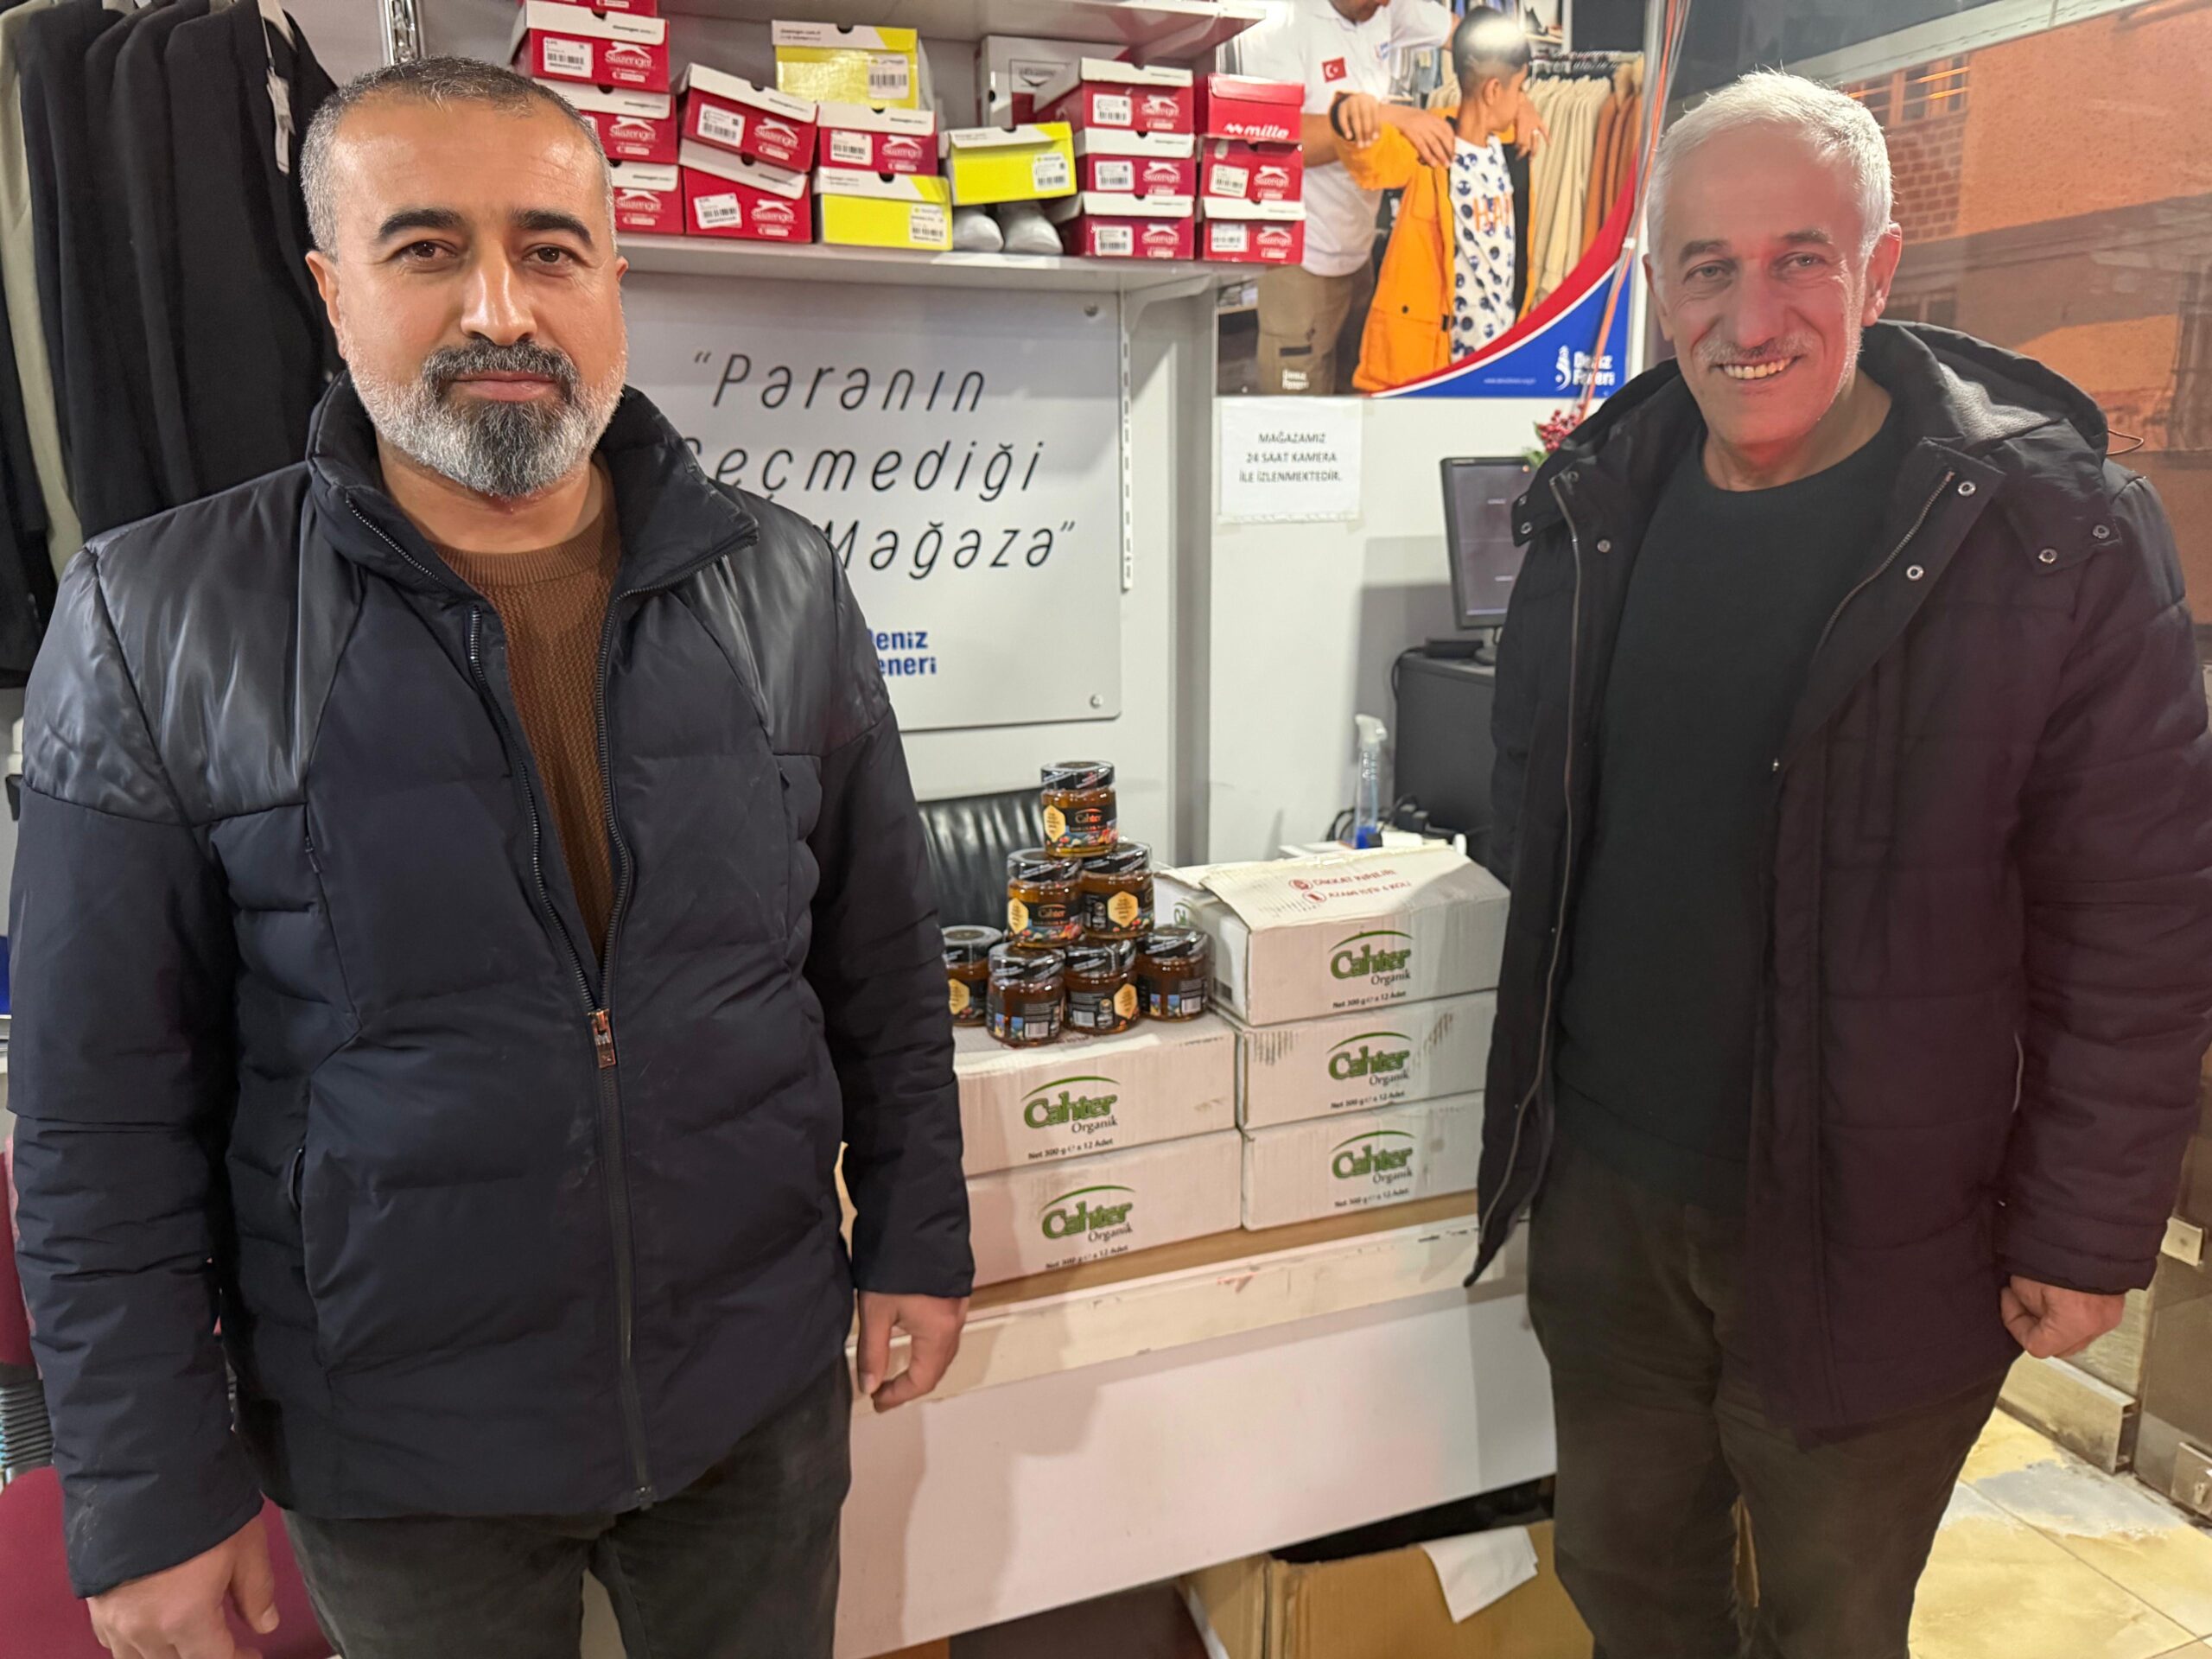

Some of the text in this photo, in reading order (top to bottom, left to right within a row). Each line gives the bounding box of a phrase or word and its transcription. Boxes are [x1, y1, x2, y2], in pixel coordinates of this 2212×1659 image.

[1258, 431, 1326, 443] MAĞAZAMIZ
[1262, 453, 1288, 462] SAAT
[1291, 452, 1338, 462] KAMERA
[1331, 944, 1411, 978] Cahter
[1370, 968, 1410, 986] Organik
[1329, 1045, 1410, 1080] Cahter
[1370, 1070, 1408, 1086] Organik
[1024, 1090, 1117, 1128] Cahter
[1071, 1115, 1117, 1134] Organik
[1332, 1144, 1413, 1179] Cahter
[1372, 1166, 1412, 1184] Organik
[1042, 1200, 1133, 1239] Cahter
[1088, 1222, 1132, 1243] Organik
